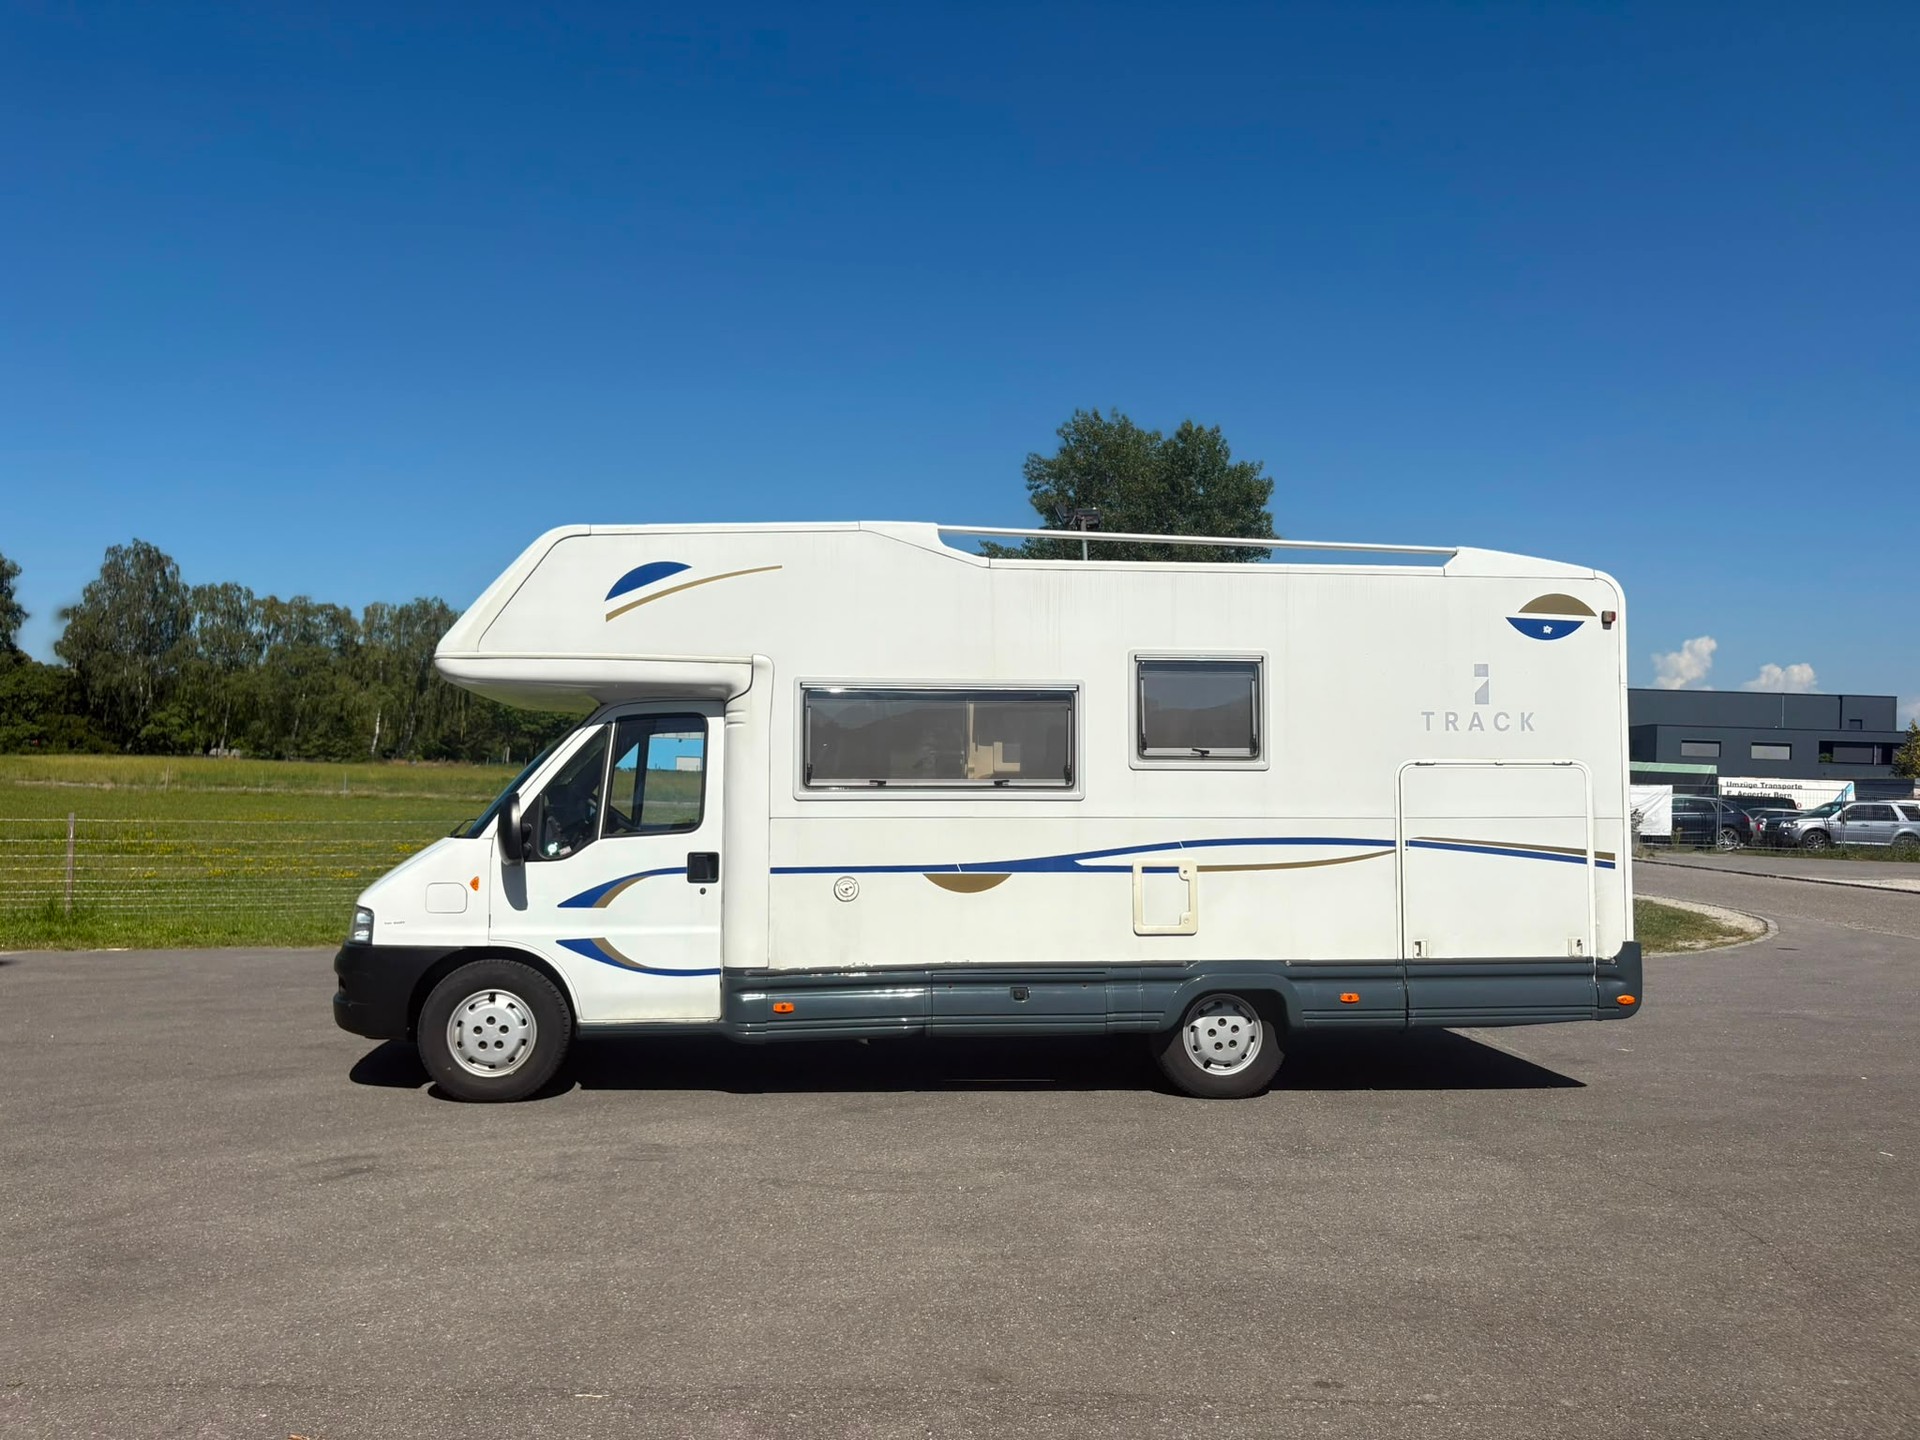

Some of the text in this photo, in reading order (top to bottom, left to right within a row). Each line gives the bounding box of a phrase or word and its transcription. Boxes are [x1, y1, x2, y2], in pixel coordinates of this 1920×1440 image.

[1420, 711, 1536, 732] TRACK
[1726, 781, 1803, 790] Umzüge Transporte
[1773, 791, 1793, 799] Bern
